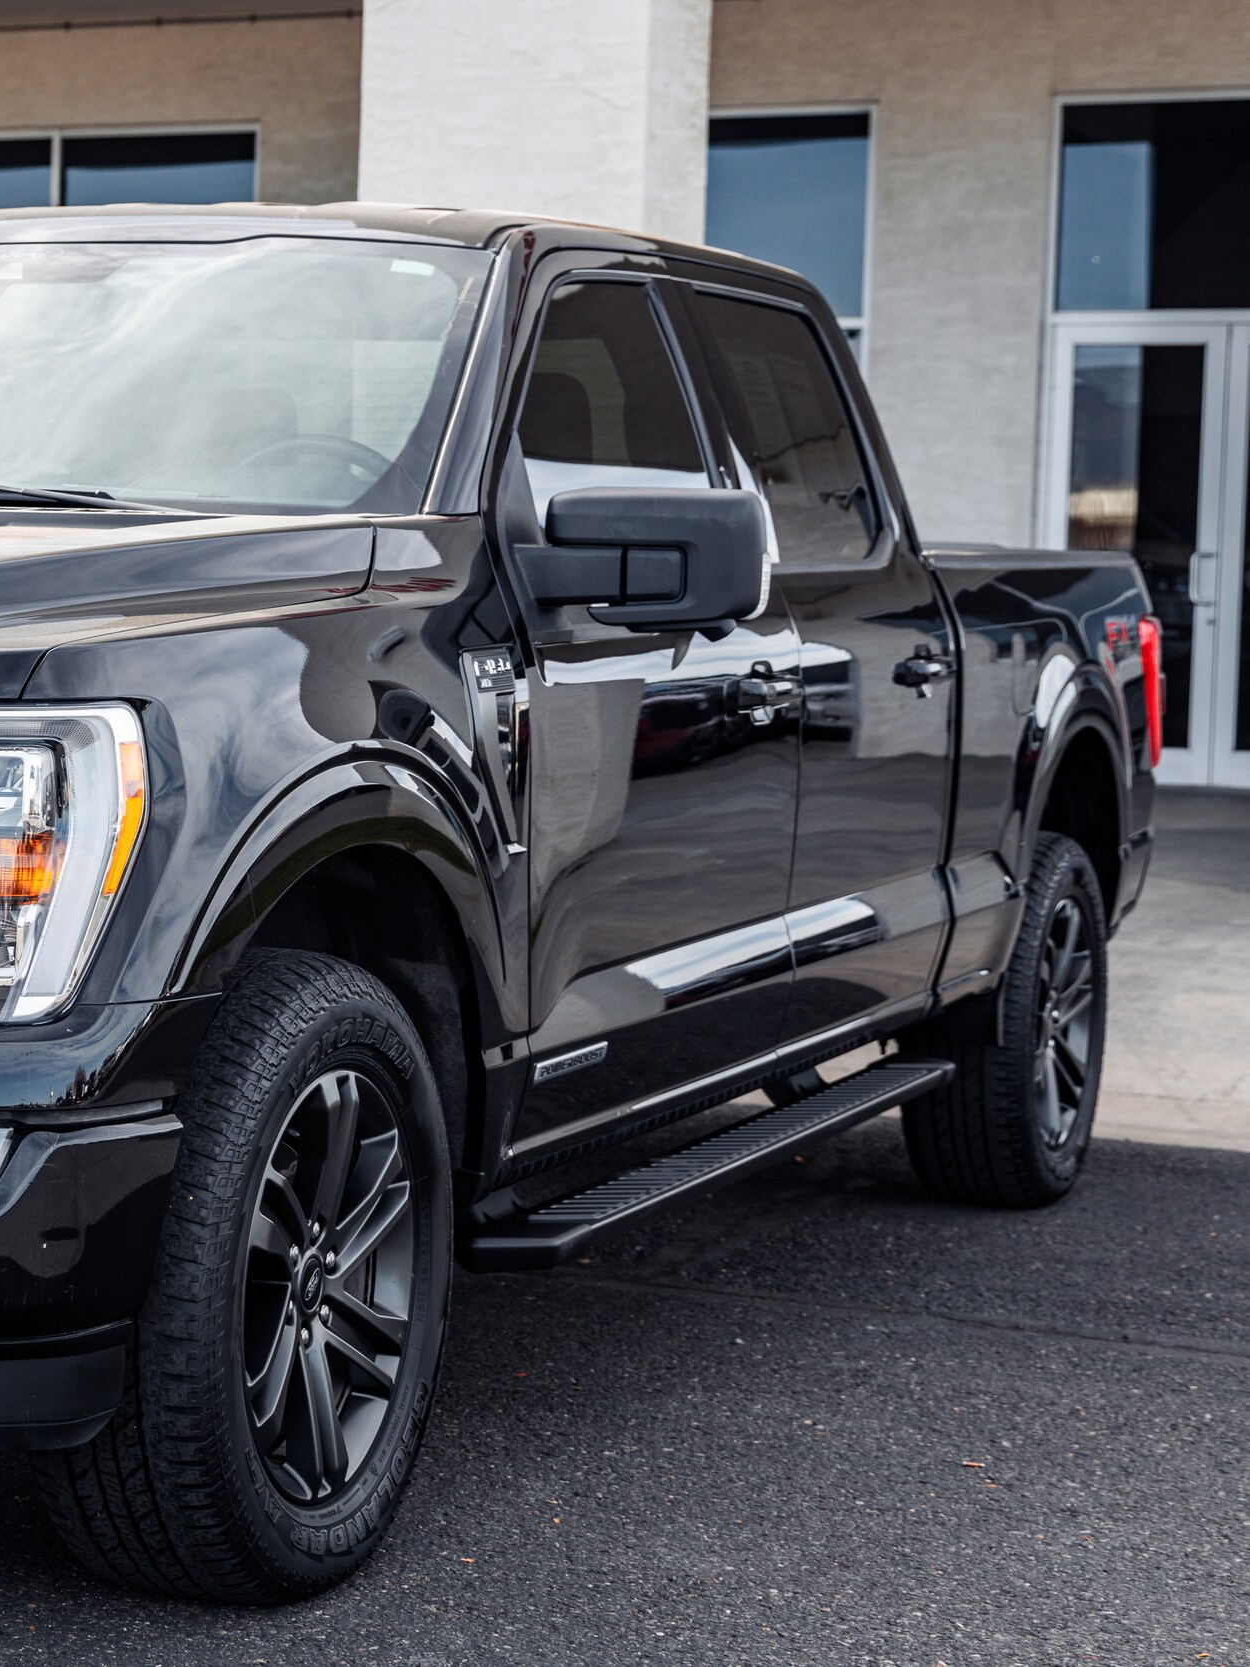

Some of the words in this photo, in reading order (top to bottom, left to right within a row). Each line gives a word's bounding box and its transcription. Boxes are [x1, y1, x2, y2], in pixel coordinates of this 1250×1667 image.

[289, 1018, 414, 1095] YOKOHAMA
[539, 1045, 606, 1078] POWERBOOST
[290, 1378, 429, 1556] GEOLANDAR
